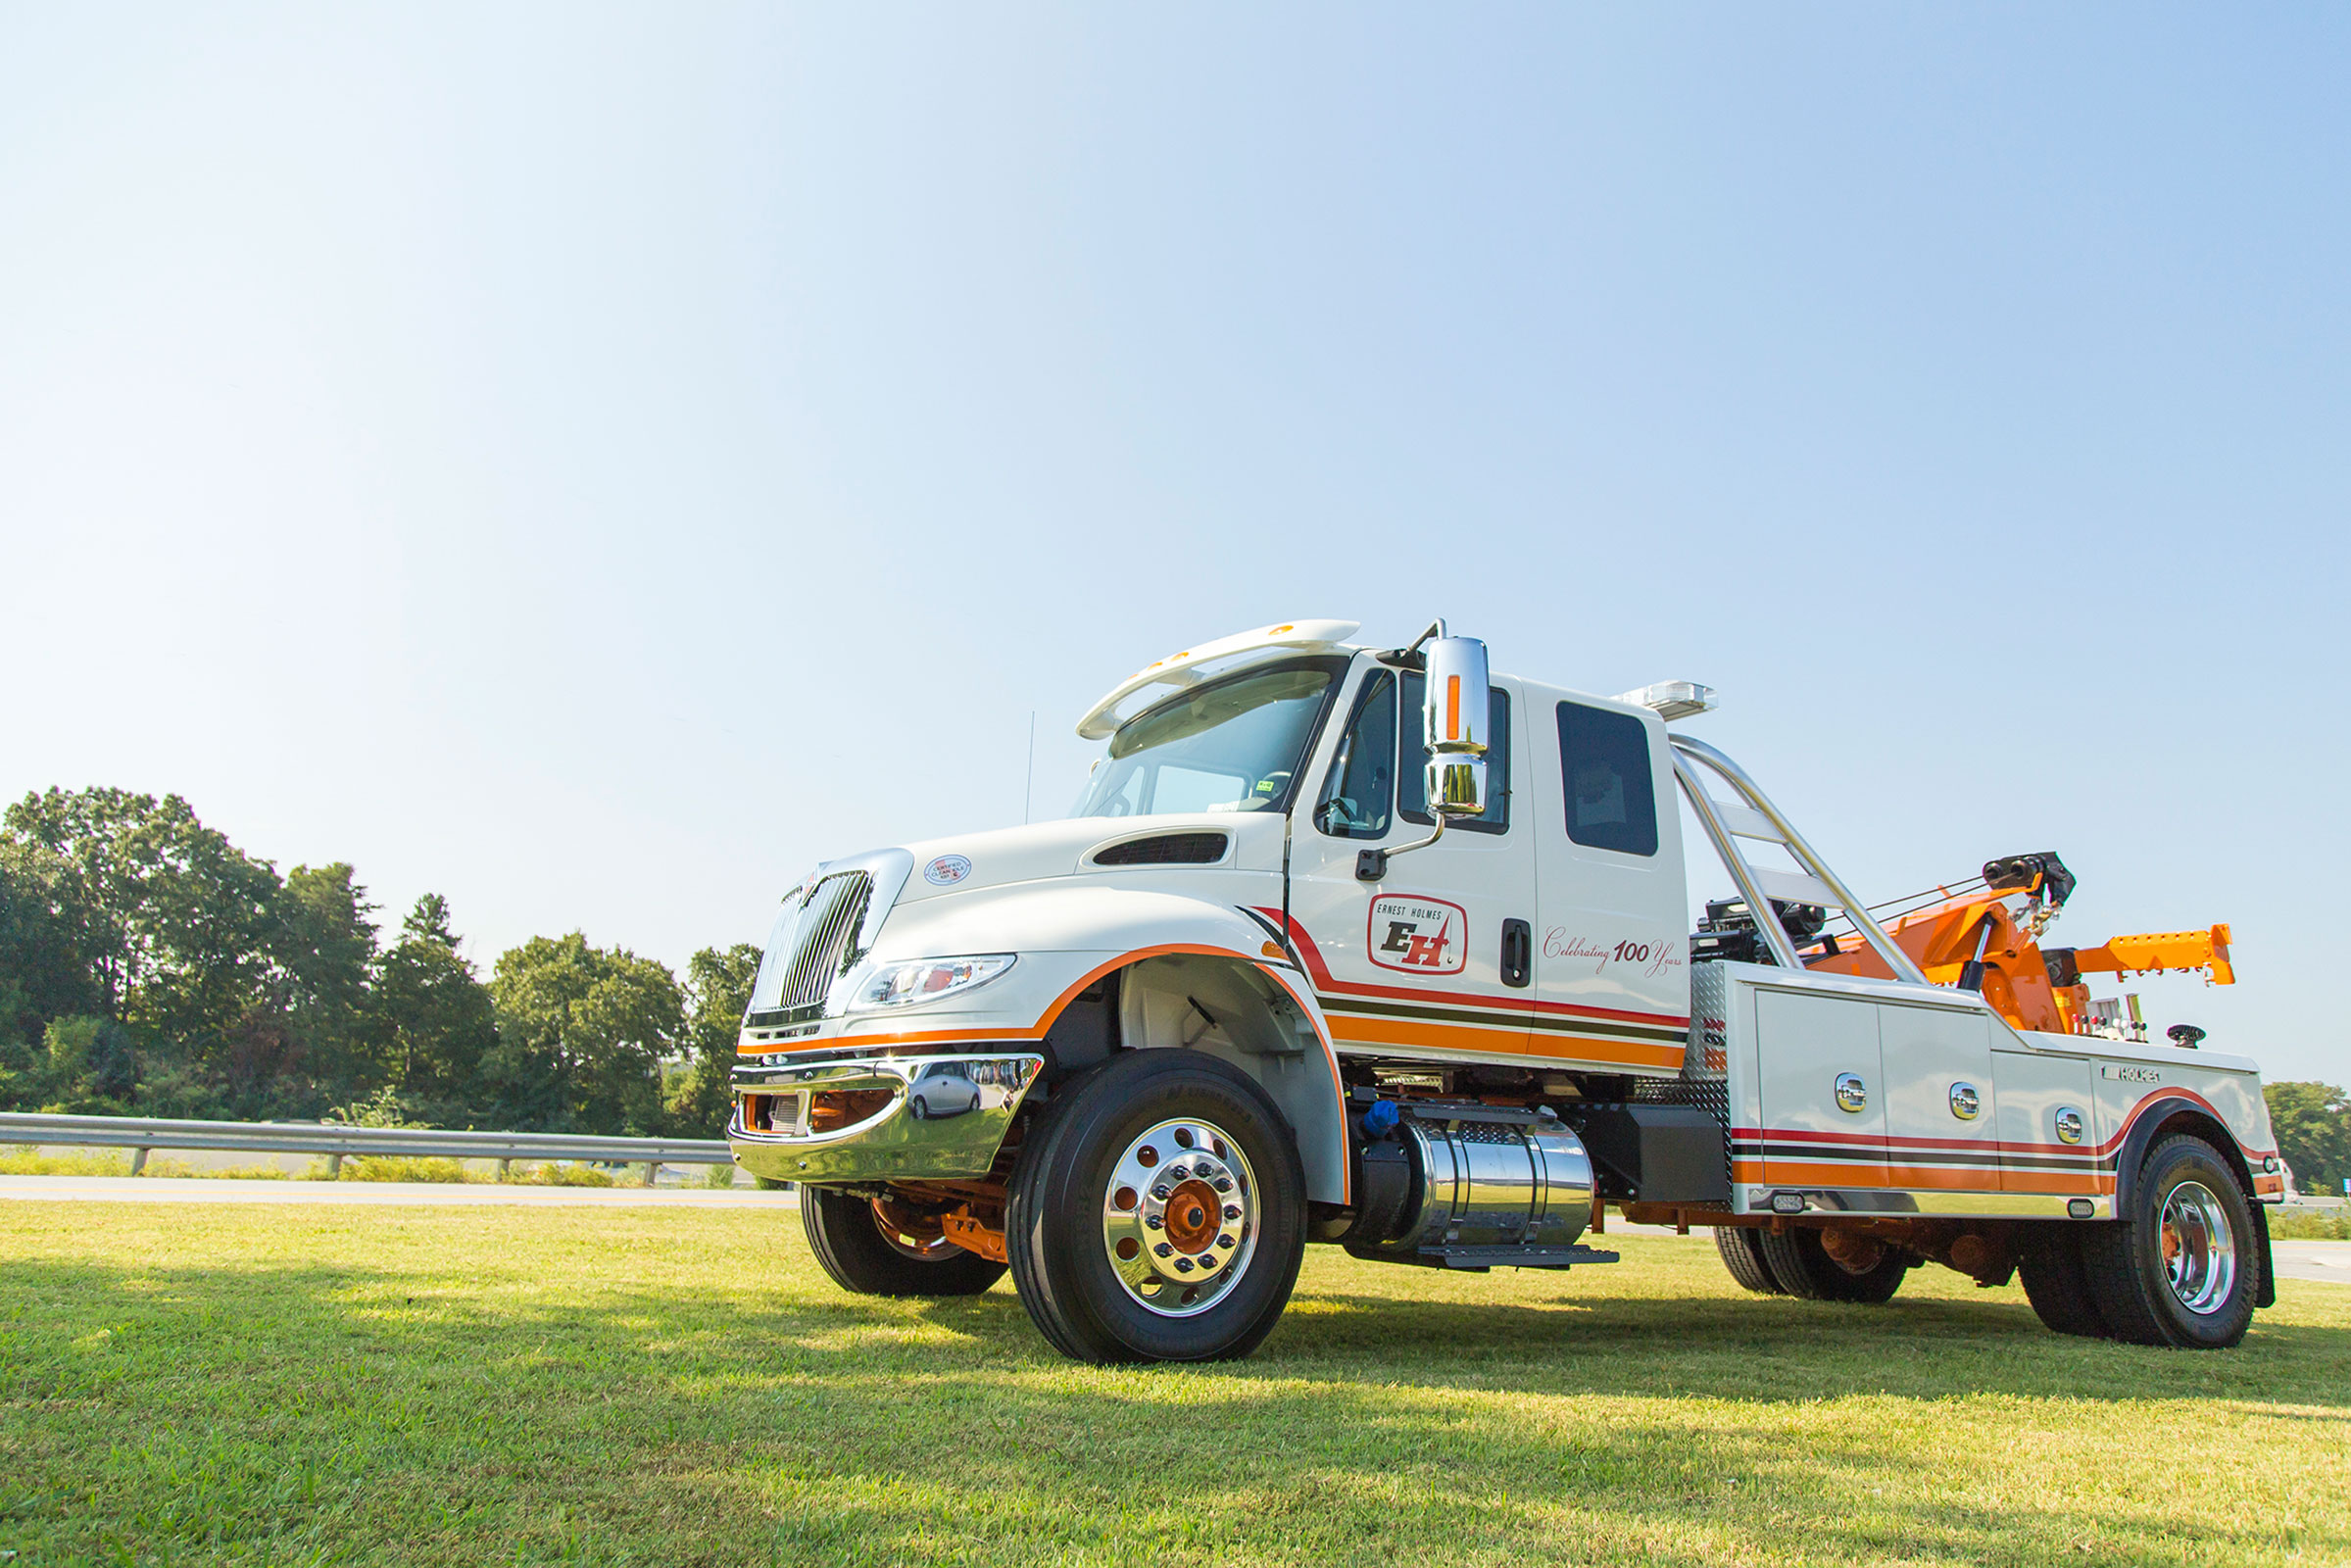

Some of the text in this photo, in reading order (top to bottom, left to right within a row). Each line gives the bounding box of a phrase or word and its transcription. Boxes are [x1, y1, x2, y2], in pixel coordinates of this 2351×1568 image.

[1377, 904, 1443, 920] ERNEST HOLMES
[1380, 920, 1449, 967] EH
[1543, 925, 1683, 978] Celebrating 100 Years
